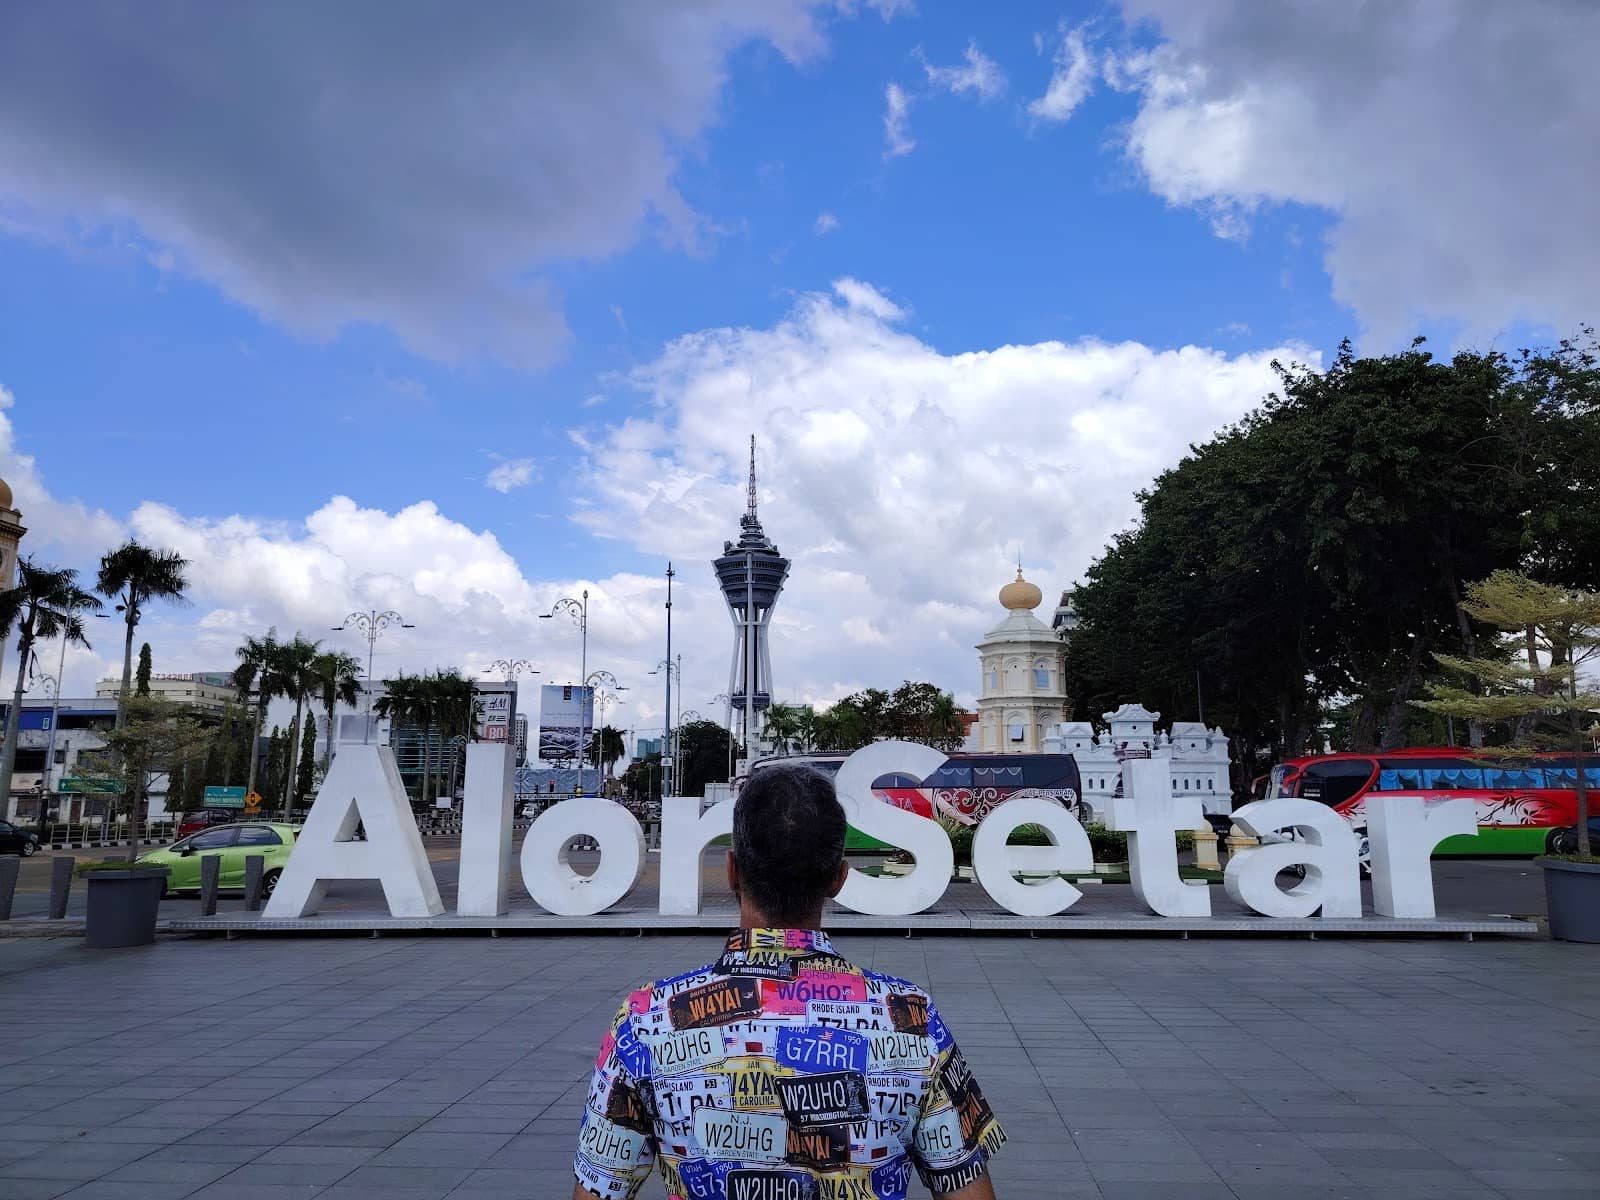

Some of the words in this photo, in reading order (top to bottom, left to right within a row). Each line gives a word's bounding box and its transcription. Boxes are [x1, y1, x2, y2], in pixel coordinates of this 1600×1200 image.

[263, 743, 735, 918] Alor
[836, 741, 1478, 919] Setar
[740, 967, 777, 976] WASHINGTON
[811, 1003, 834, 1013] RHODE
[836, 1004, 860, 1014] ISLAND
[844, 1034, 862, 1046] 1950
[786, 1036, 860, 1071] G7RRL
[868, 1035, 929, 1061] W2UHG
[740, 1096, 774, 1106] CAROLINA
[782, 1079, 847, 1112] W2UHQ
[729, 1114, 752, 1125] N.J.
[810, 1110, 849, 1121] WASHINGTON
[705, 1122, 773, 1152] W2UHG
[715, 1162, 733, 1175] 1950
[734, 1177, 799, 1200] W2UHQ
